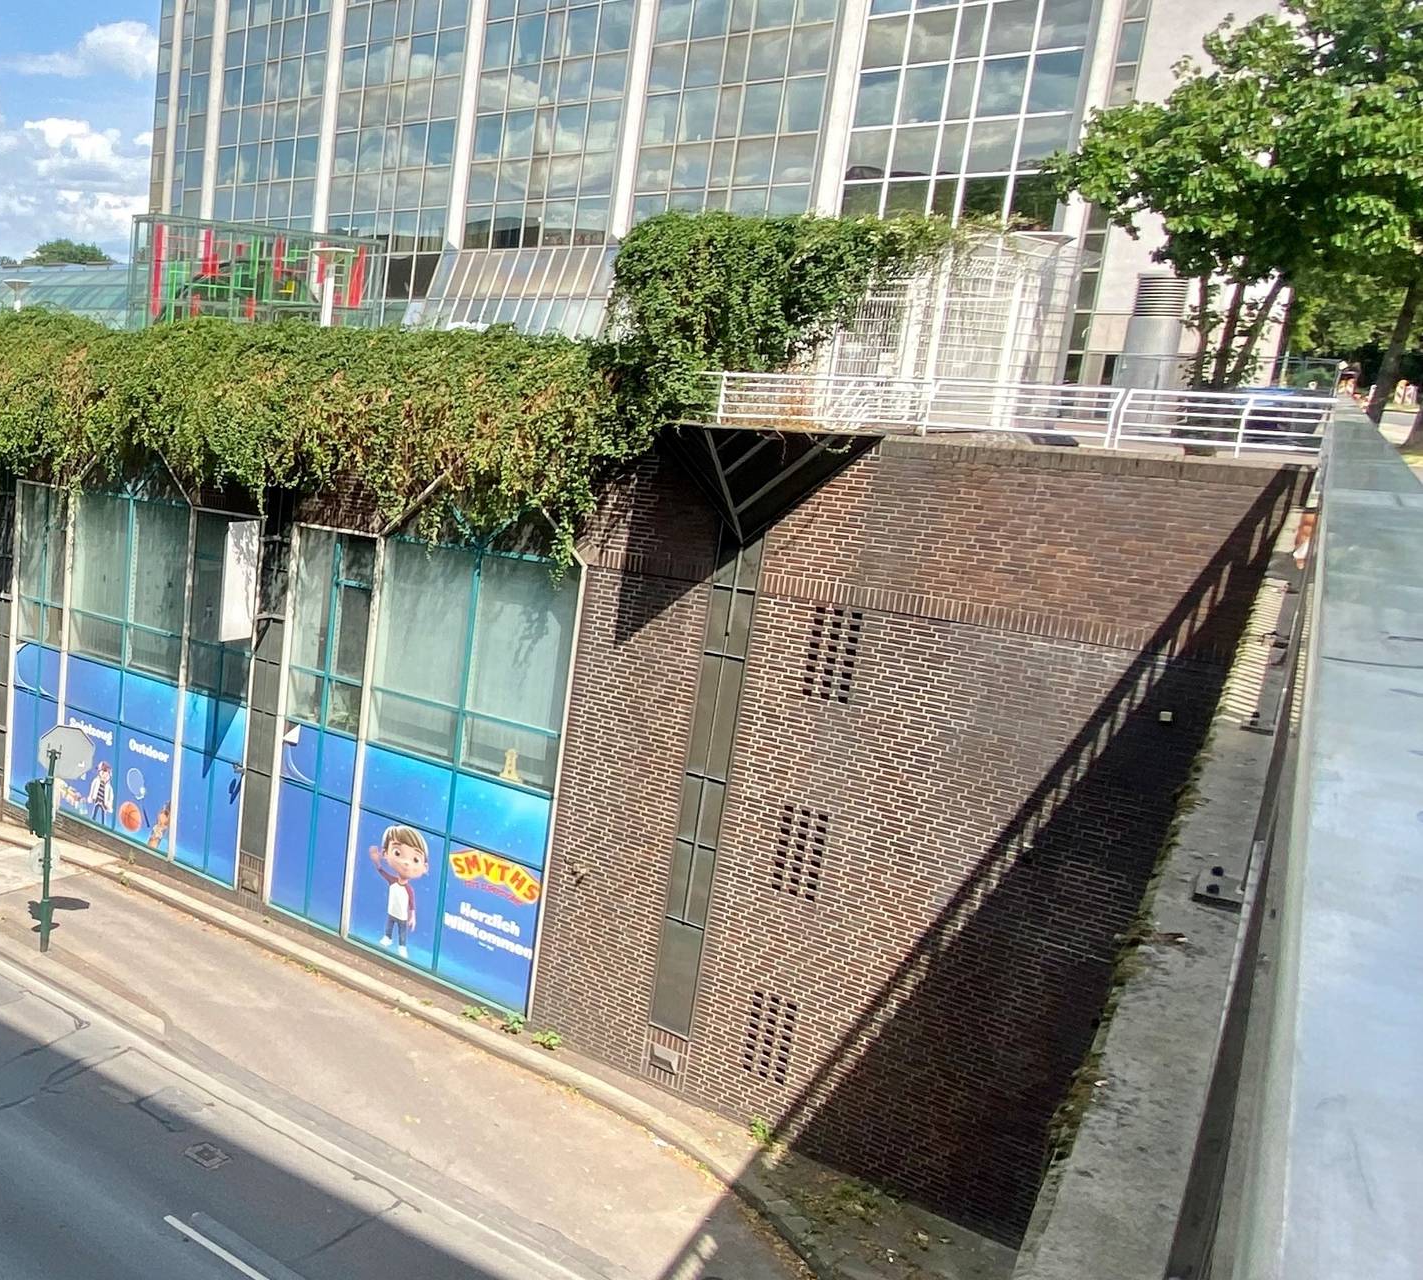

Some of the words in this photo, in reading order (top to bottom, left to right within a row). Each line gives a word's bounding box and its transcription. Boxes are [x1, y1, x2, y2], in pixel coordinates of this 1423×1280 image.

[128, 738, 169, 763] Outdoor
[451, 854, 539, 902] SMYTHS
[444, 911, 533, 960] Willkommen
[460, 901, 520, 937] Herzlich
